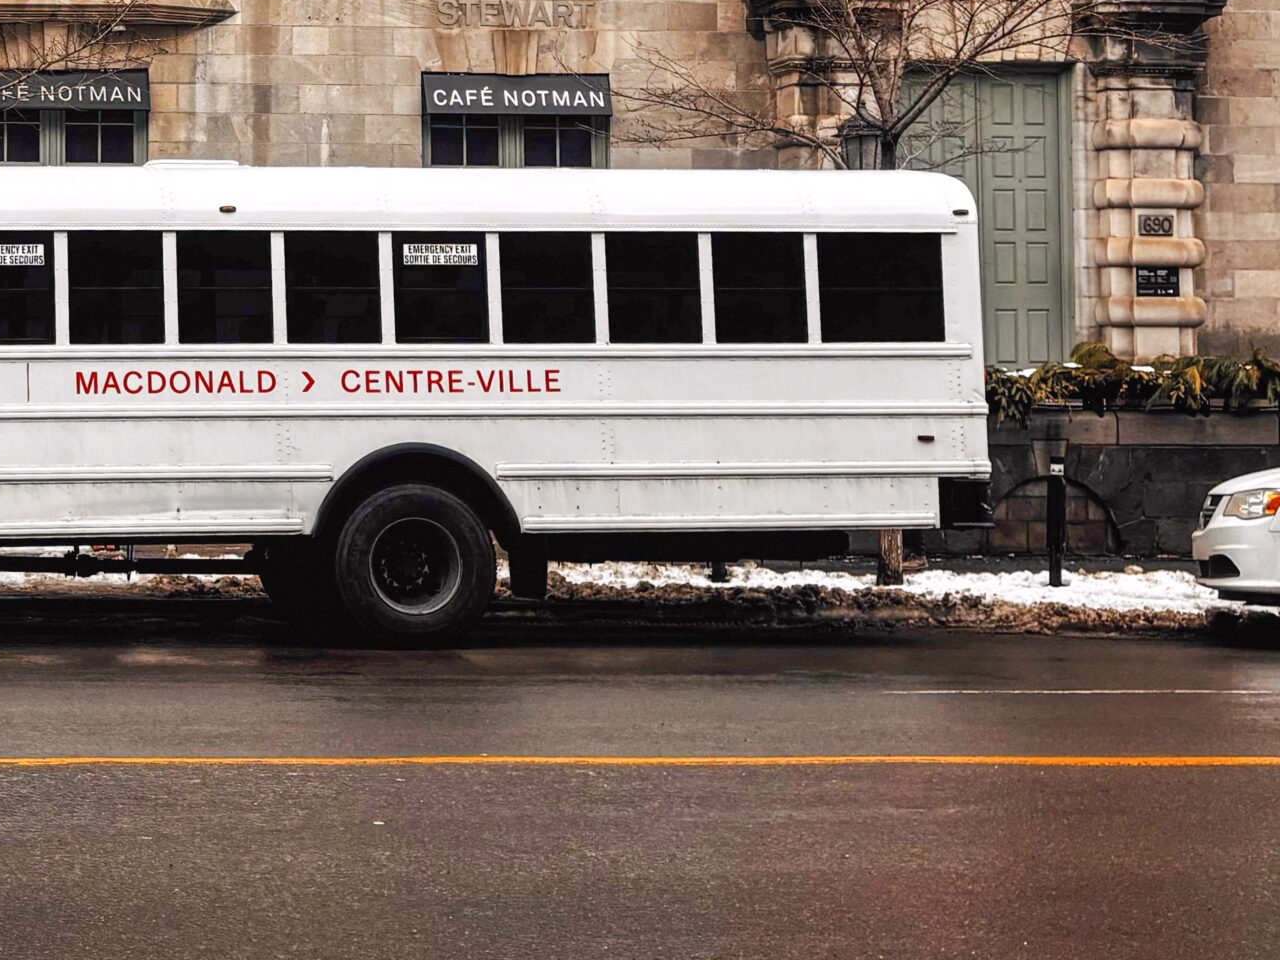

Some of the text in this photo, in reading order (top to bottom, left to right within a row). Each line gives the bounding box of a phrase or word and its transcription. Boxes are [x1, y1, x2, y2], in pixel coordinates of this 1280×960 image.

[40, 85, 142, 102] NOTMAN
[433, 86, 605, 108] CAFÉ NOTMAN
[1143, 217, 1172, 233] 690
[21, 245, 38, 254] EXIT
[408, 245, 471, 254] EMERGENCY EXIT
[9, 255, 44, 265] SECOURS
[404, 255, 477, 264] SORTIE DE SECOURS
[75, 370, 277, 395] MACDONALD
[341, 369, 562, 393] CENTRE-VILLE
